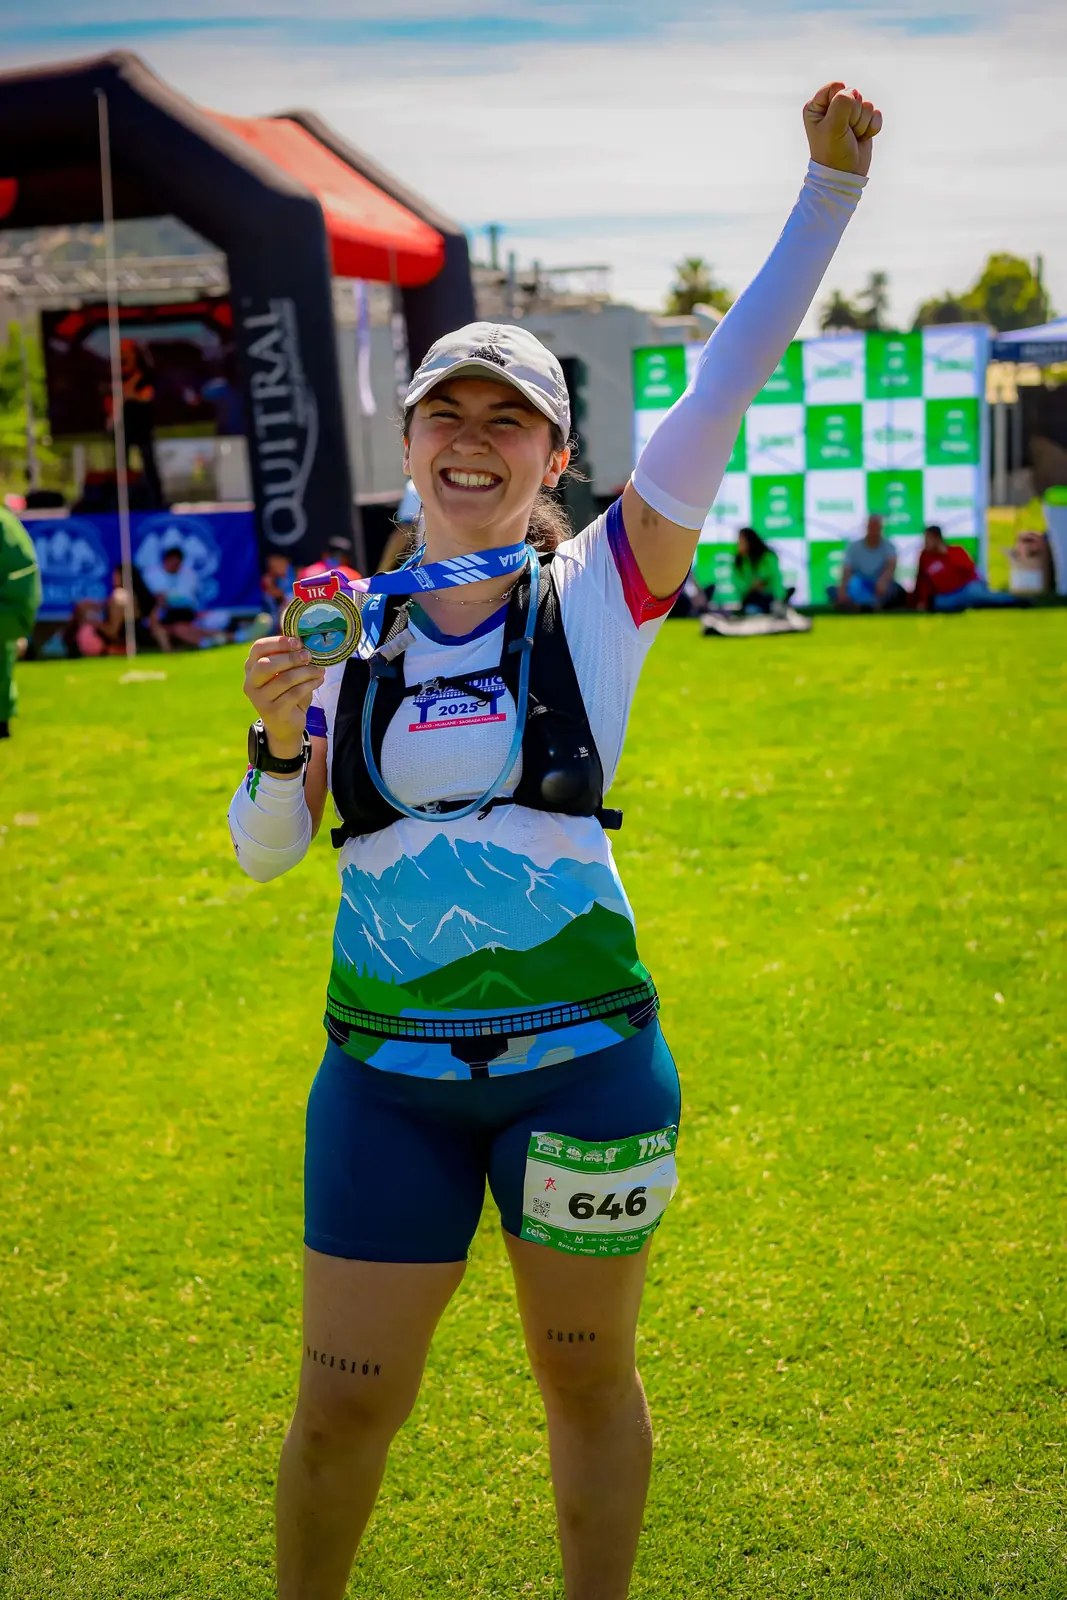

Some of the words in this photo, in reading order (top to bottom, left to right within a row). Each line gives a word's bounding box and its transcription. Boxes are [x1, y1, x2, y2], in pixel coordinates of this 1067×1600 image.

[243, 298, 319, 546] QUITRAL
[306, 586, 327, 599] 11K
[438, 703, 478, 716] 2025
[638, 1131, 672, 1160] 11K
[568, 1186, 648, 1221] 646
